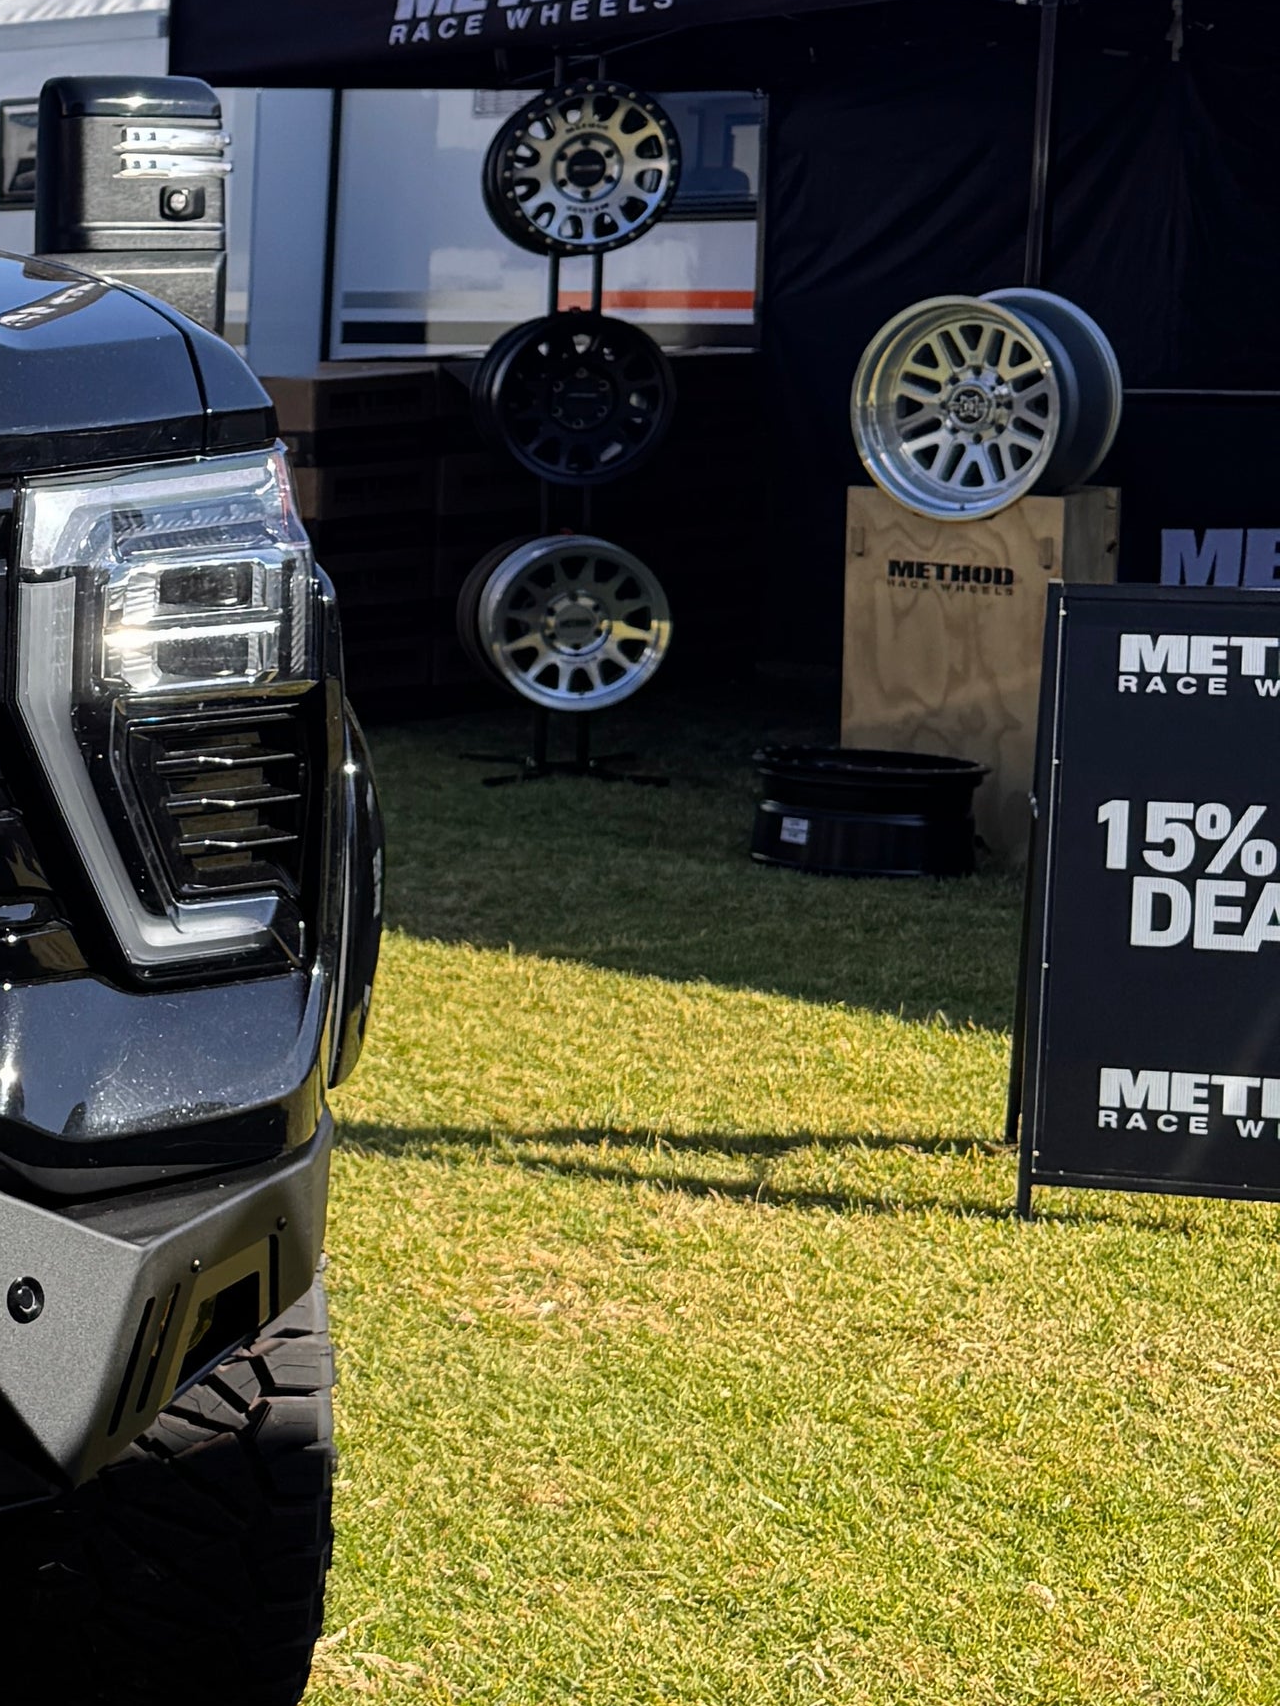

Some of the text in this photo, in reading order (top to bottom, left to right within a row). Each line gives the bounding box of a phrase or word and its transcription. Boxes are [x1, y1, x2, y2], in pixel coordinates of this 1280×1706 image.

[389, 13, 484, 46] RACE
[887, 579, 1014, 596] RACE WHEELS
[888, 559, 1014, 586] METHOD
[1119, 633, 1280, 676] MET
[1117, 674, 1228, 695] RACE
[1097, 799, 1278, 877] 15%
[1098, 1109, 1280, 1139] RACE W
